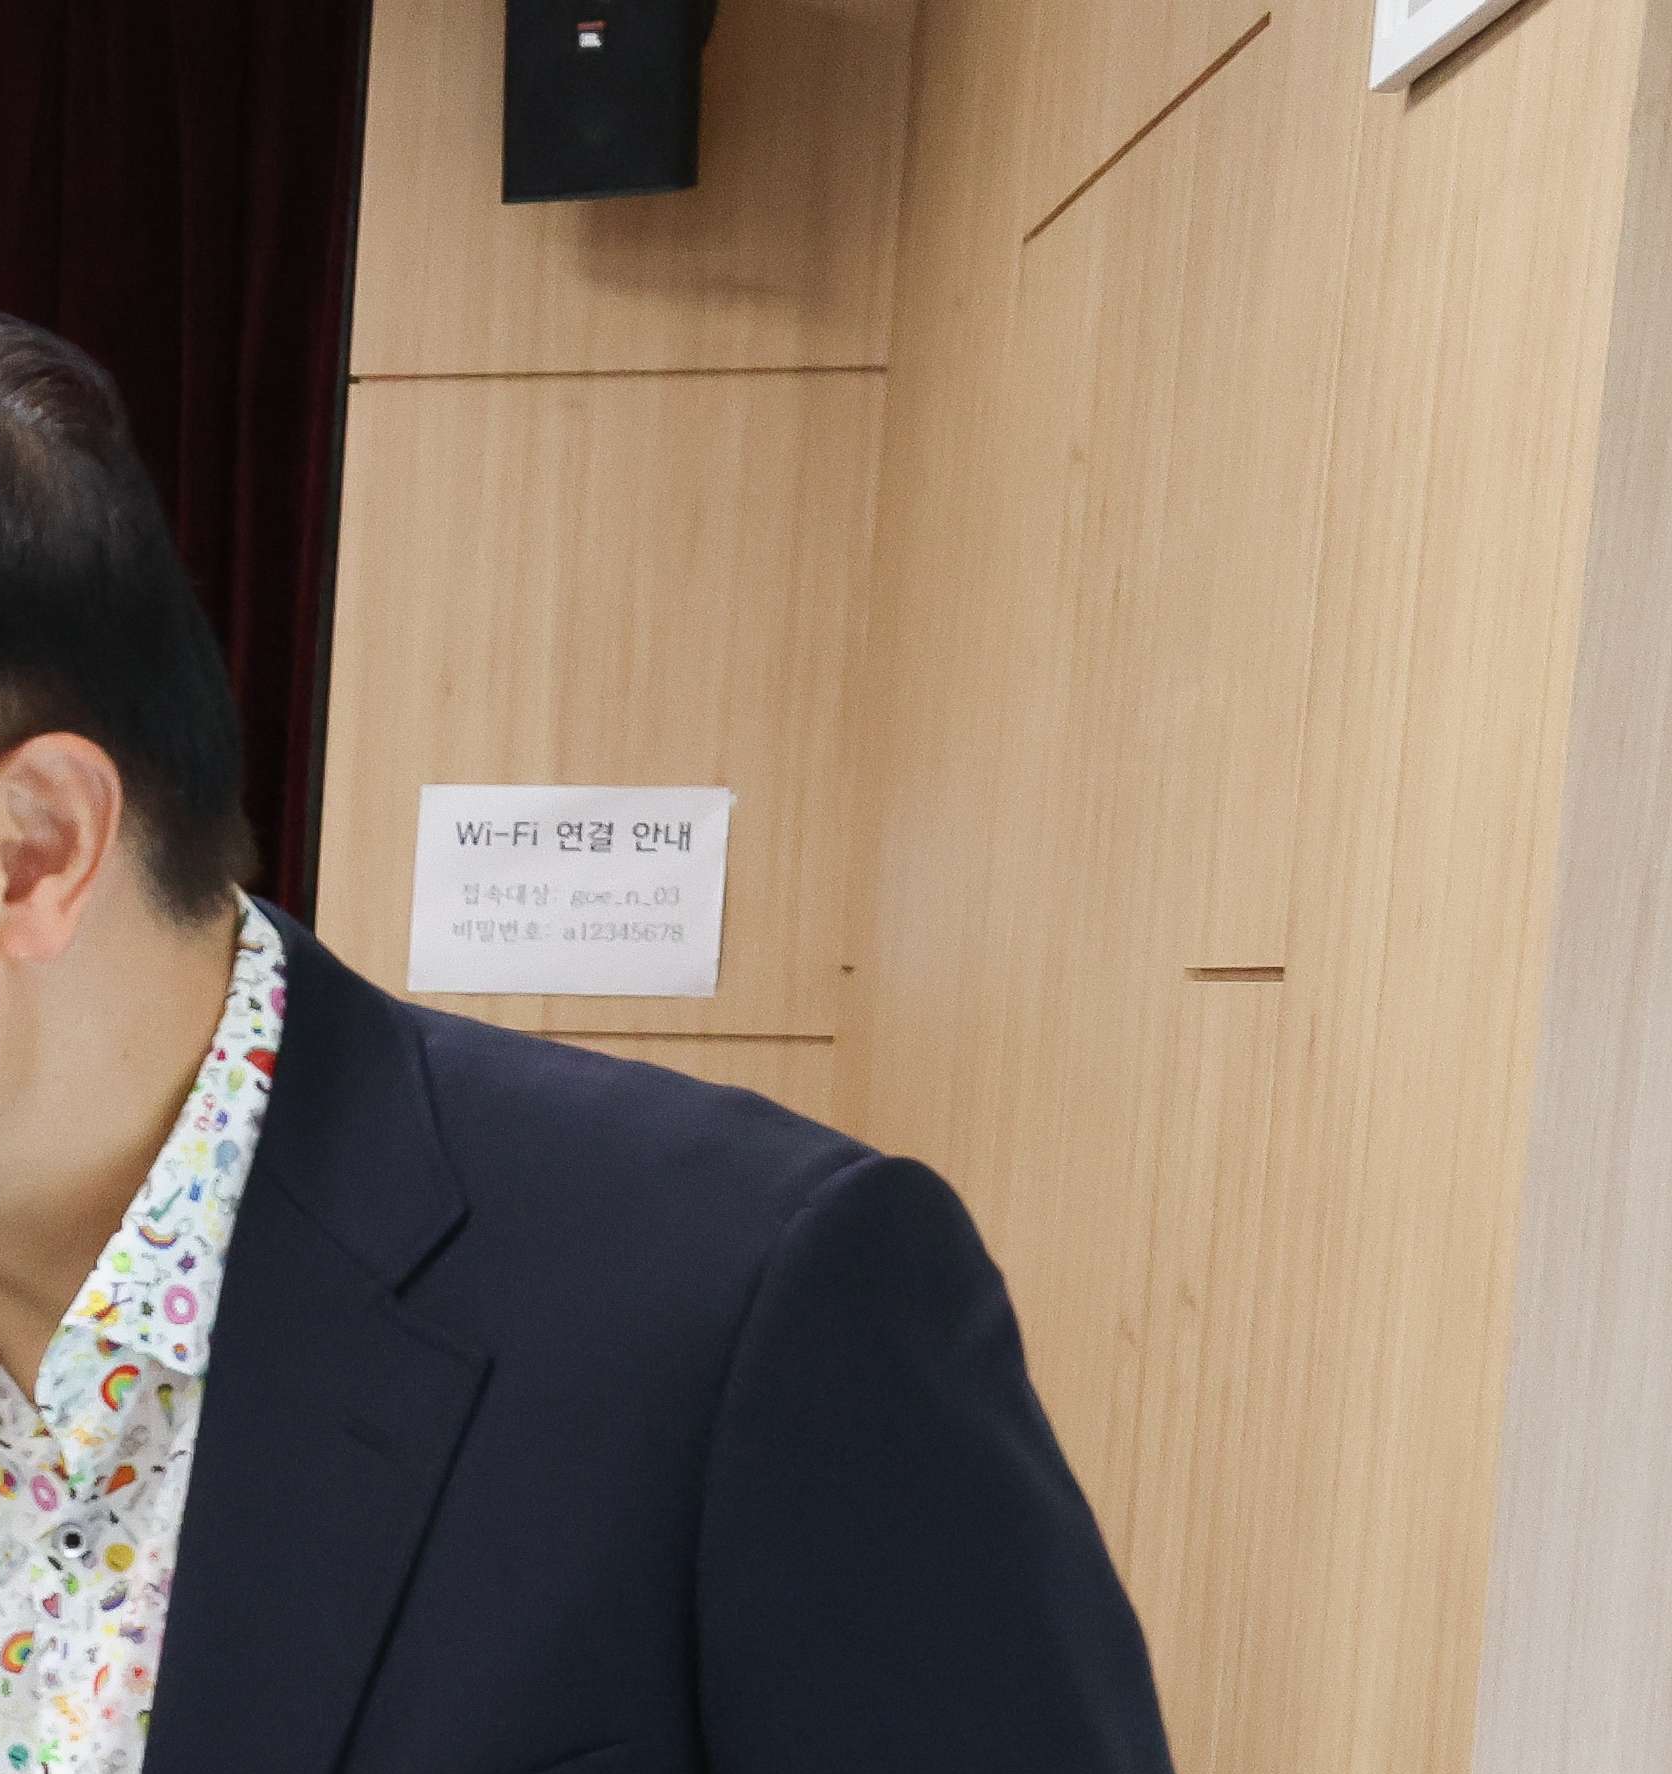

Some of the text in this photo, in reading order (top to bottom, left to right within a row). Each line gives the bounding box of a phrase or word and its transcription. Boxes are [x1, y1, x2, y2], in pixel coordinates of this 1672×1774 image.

[455, 820, 693, 854] Wi-Fi 연결 안내
